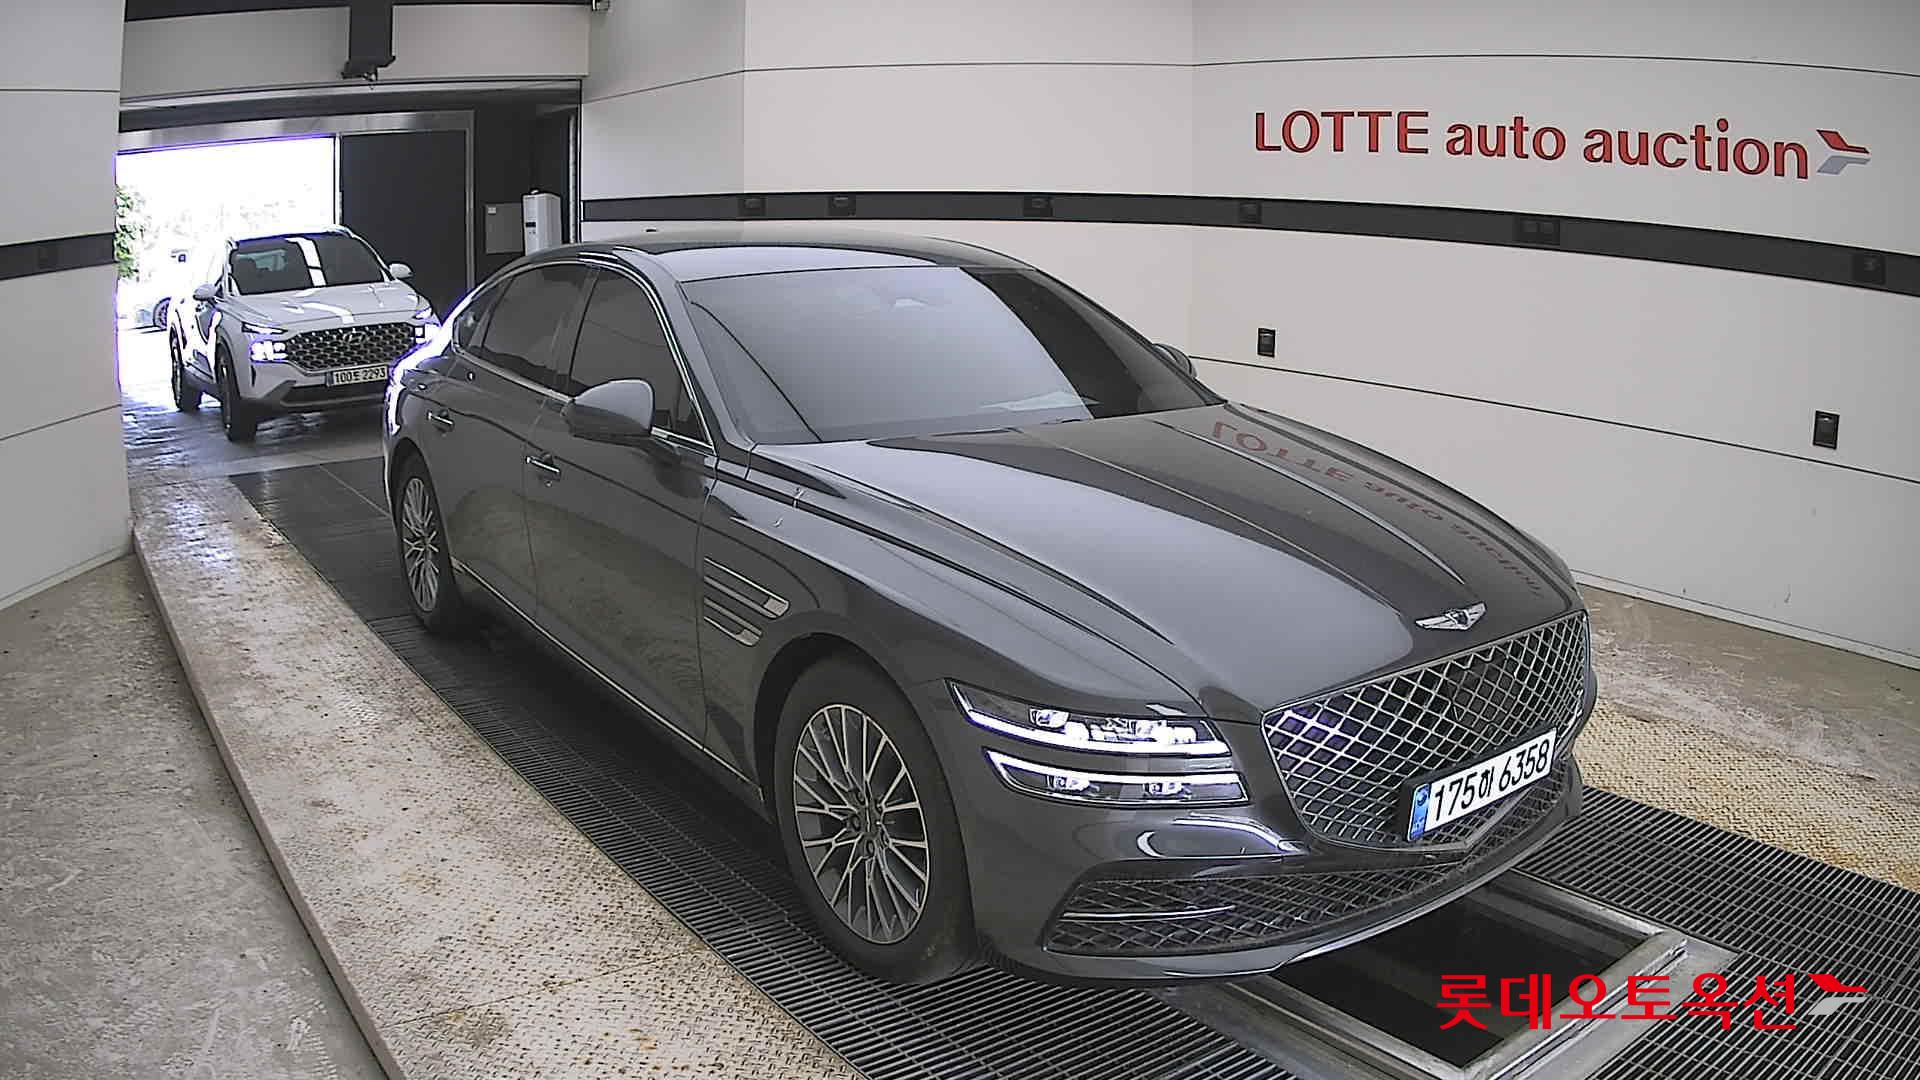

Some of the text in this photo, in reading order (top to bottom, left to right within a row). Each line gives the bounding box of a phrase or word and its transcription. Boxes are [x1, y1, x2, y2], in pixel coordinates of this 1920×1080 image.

[1255, 110, 1809, 179] LOTTE auto auction
[362, 367, 386, 381] 2293
[1499, 738, 1551, 792] 6358
